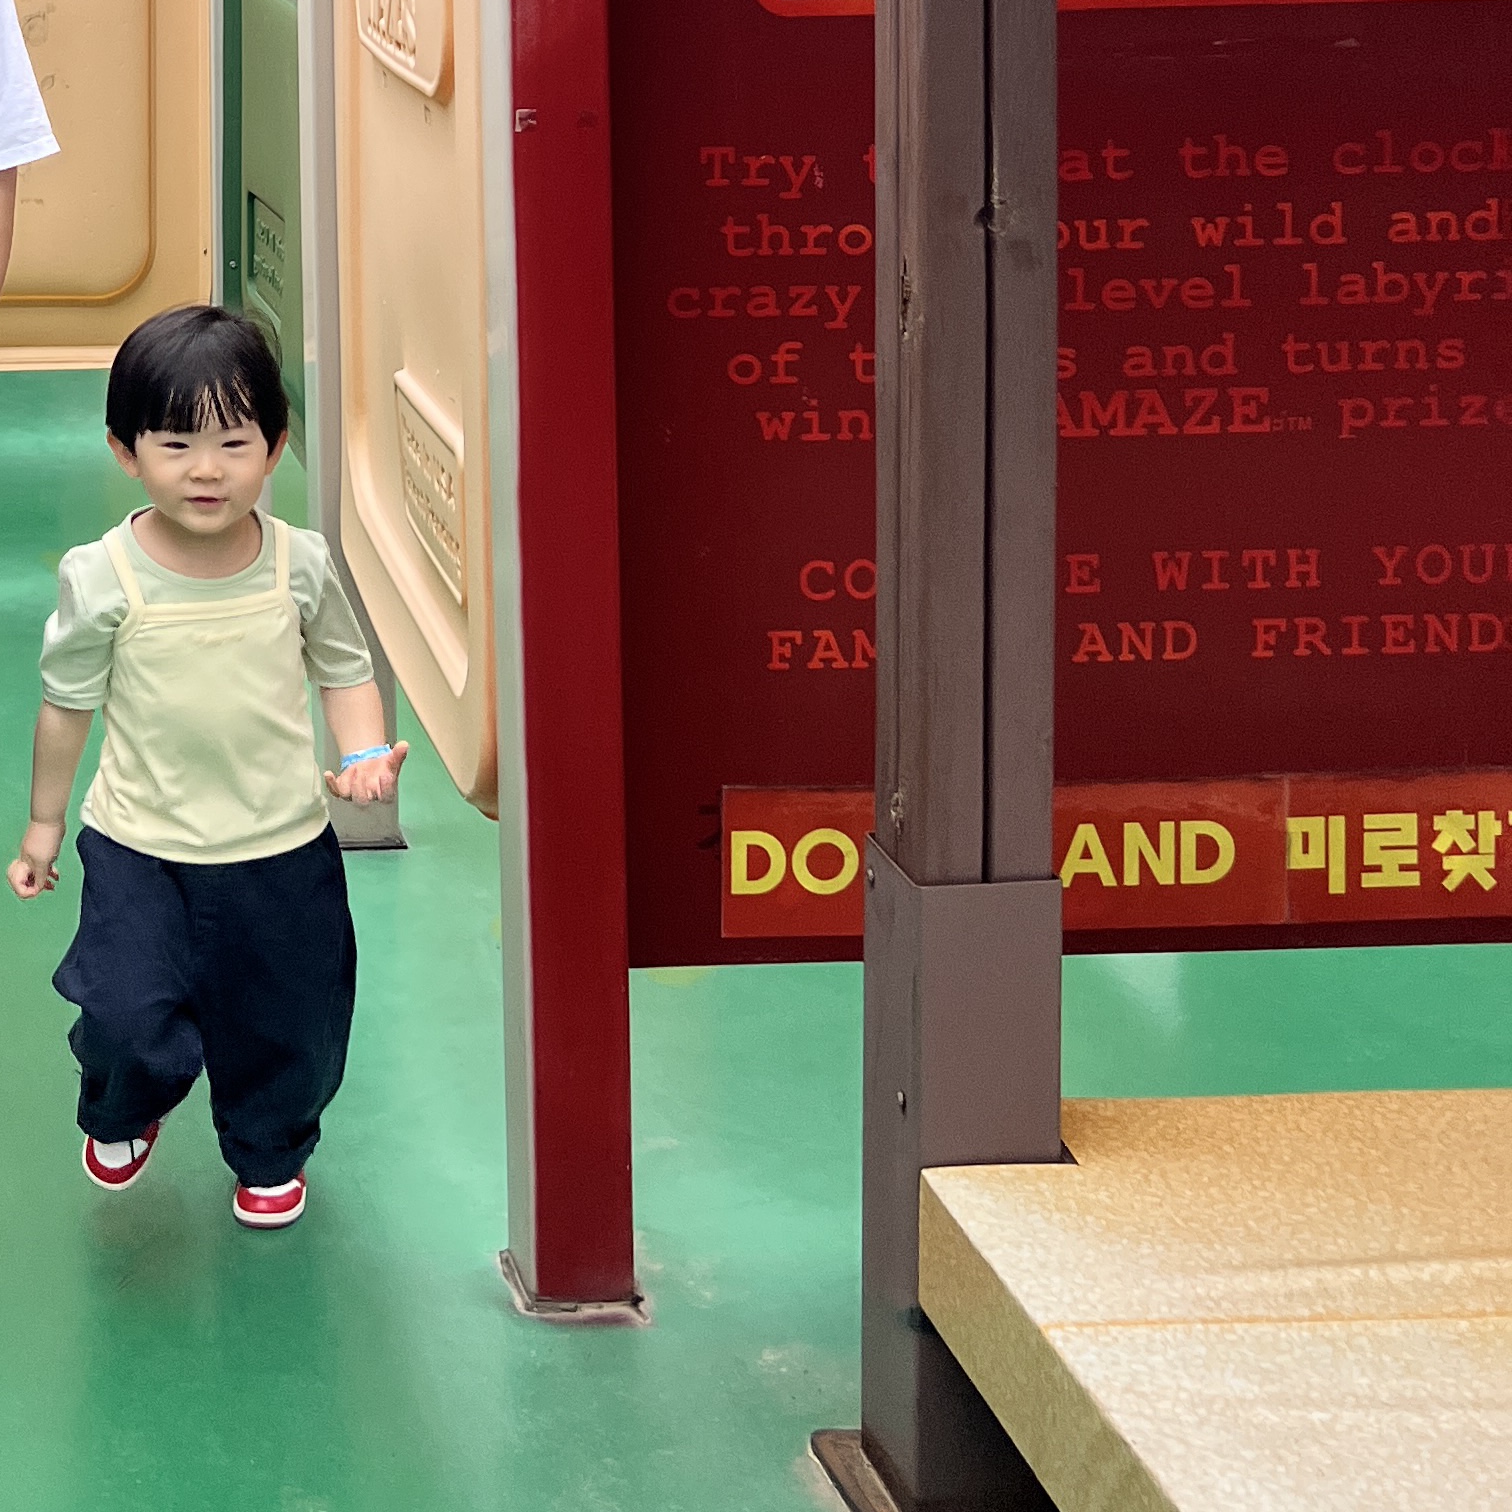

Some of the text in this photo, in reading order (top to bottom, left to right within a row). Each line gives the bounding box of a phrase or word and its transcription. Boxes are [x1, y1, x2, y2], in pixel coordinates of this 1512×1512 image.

[700, 145, 817, 200] Try
[1178, 134, 1288, 179] the
[720, 213, 873, 257] thro
[1190, 201, 1348, 246] wild
[1388, 197, 1504, 244] and
[666, 285, 863, 329] crazy
[727, 341, 804, 385] of
[1122, 332, 1239, 378] and
[1281, 333, 1466, 375] turns
[1150, 547, 1322, 592] WITH
[1371, 542, 1512, 586] YOU
[1071, 619, 1199, 663] AND
[1250, 612, 1512, 659] FRIEND
[1057, 818, 1239, 888] AND
